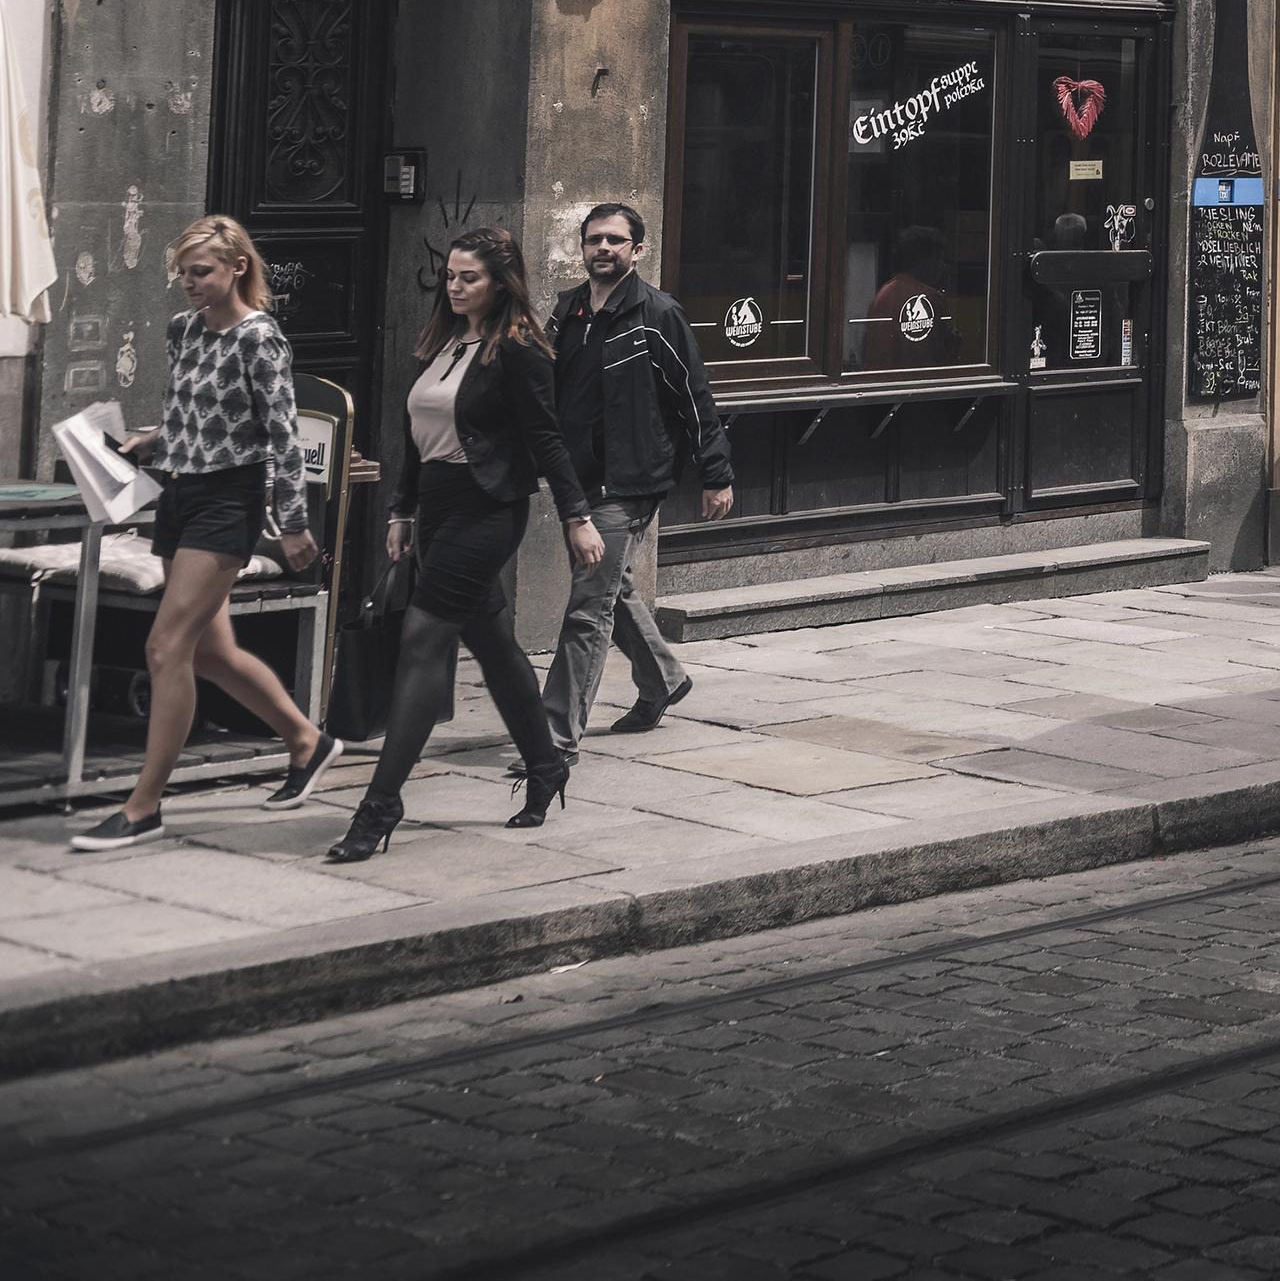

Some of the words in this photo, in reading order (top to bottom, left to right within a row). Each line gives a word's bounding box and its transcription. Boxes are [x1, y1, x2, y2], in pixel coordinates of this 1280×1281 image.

[853, 77, 942, 145] Eintopf
[939, 60, 979, 90] suppe
[725, 322, 763, 337] WEINSTUBE
[900, 318, 935, 332] WEINSTUBE
